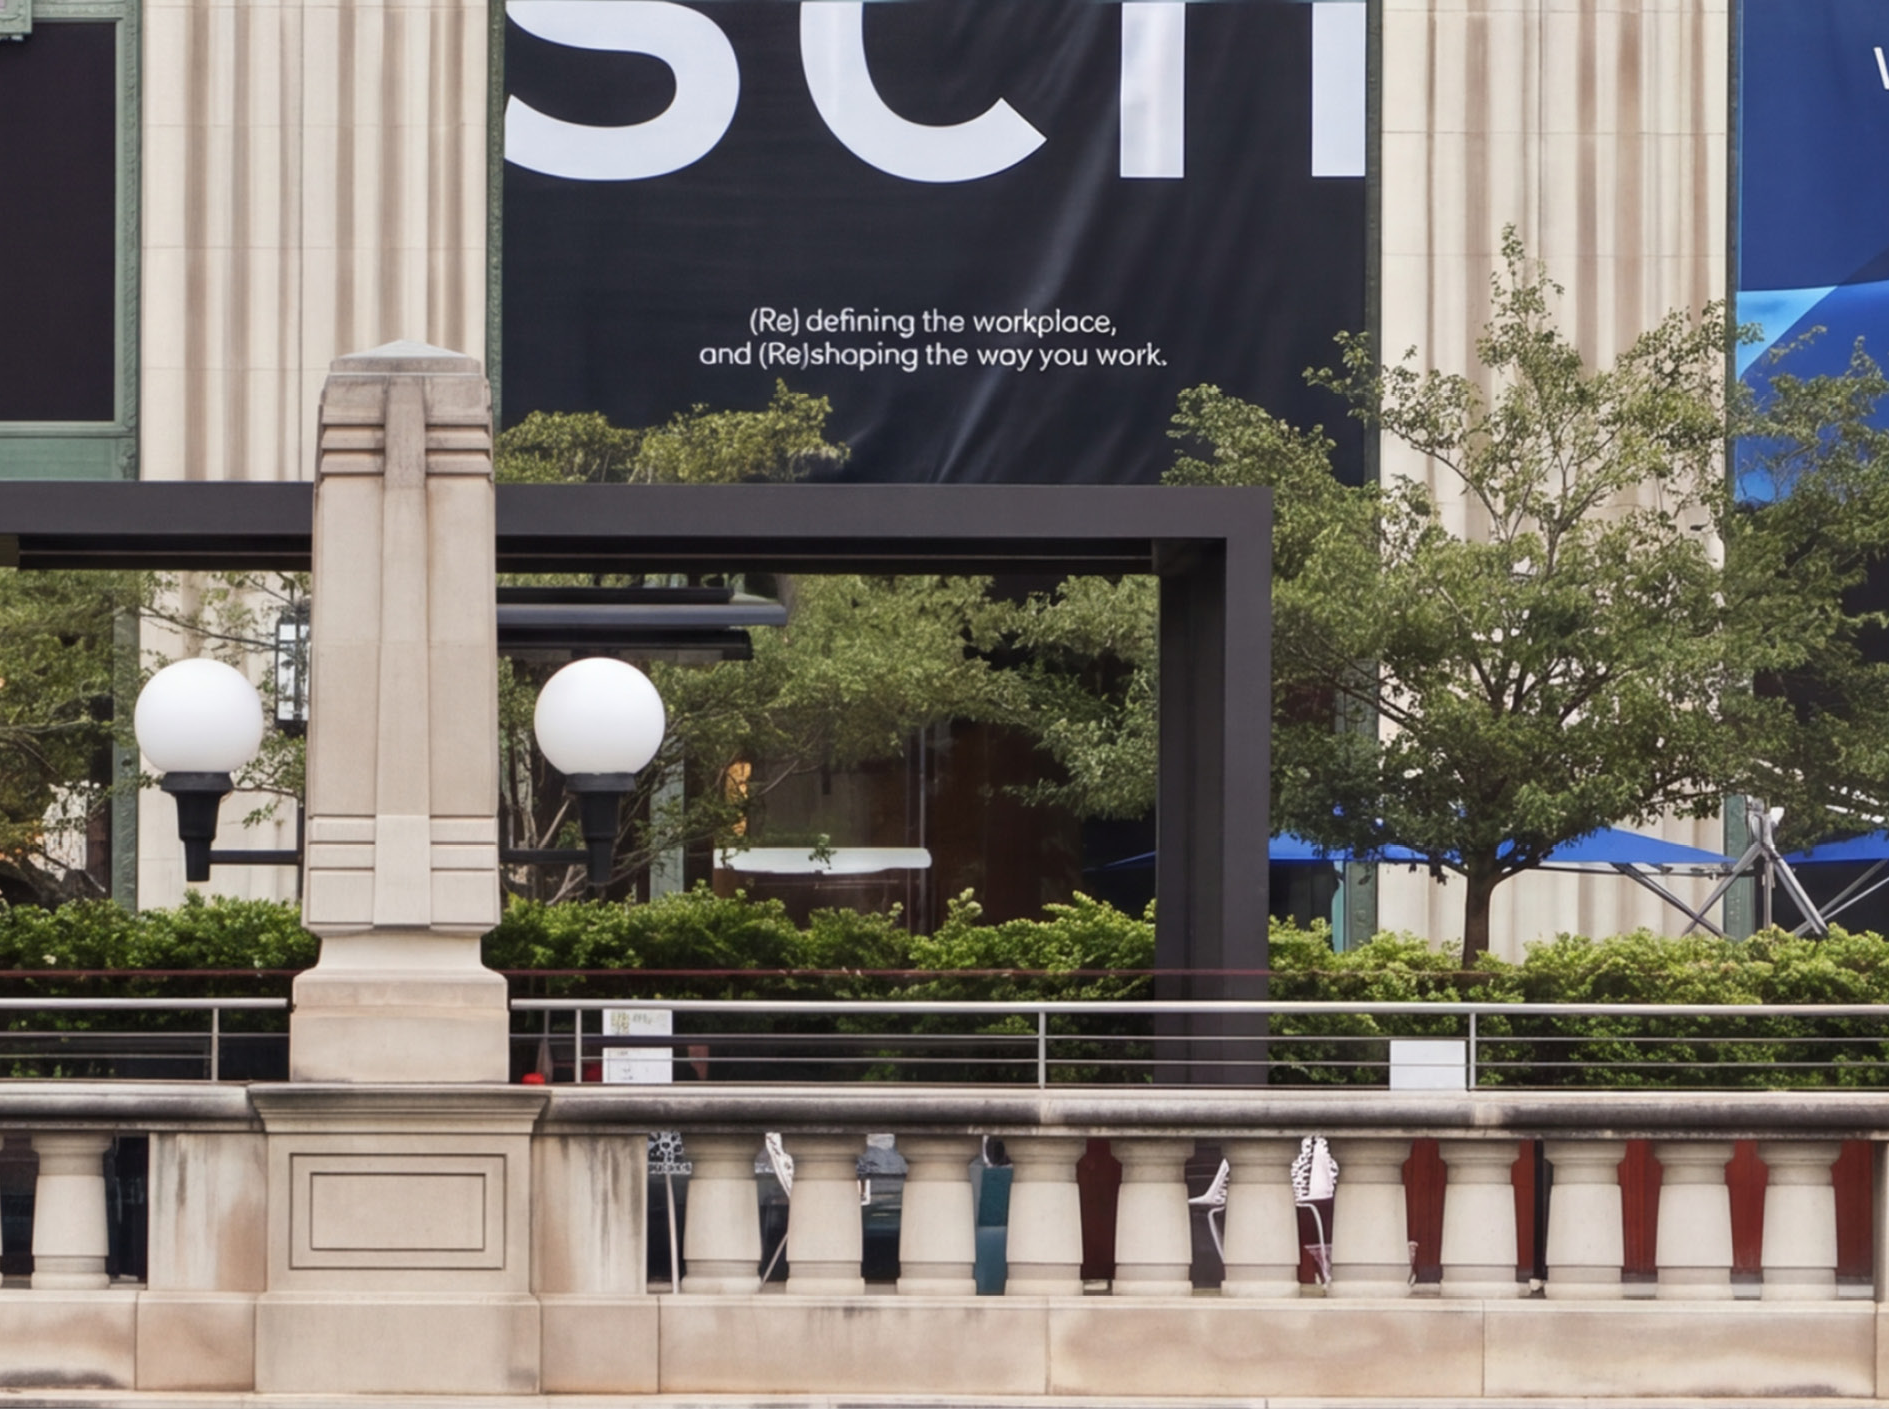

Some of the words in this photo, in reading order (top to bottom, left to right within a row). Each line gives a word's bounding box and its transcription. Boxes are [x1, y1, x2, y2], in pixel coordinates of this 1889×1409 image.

[749, 306, 800, 337] (Re)
[805, 307, 916, 339] defining
[922, 308, 966, 333] the
[972, 307, 1118, 339] workplace,
[699, 341, 752, 366] and
[925, 341, 969, 366] the
[976, 348, 1035, 372] way
[1038, 348, 1089, 372] you
[1095, 341, 1169, 367] work.
